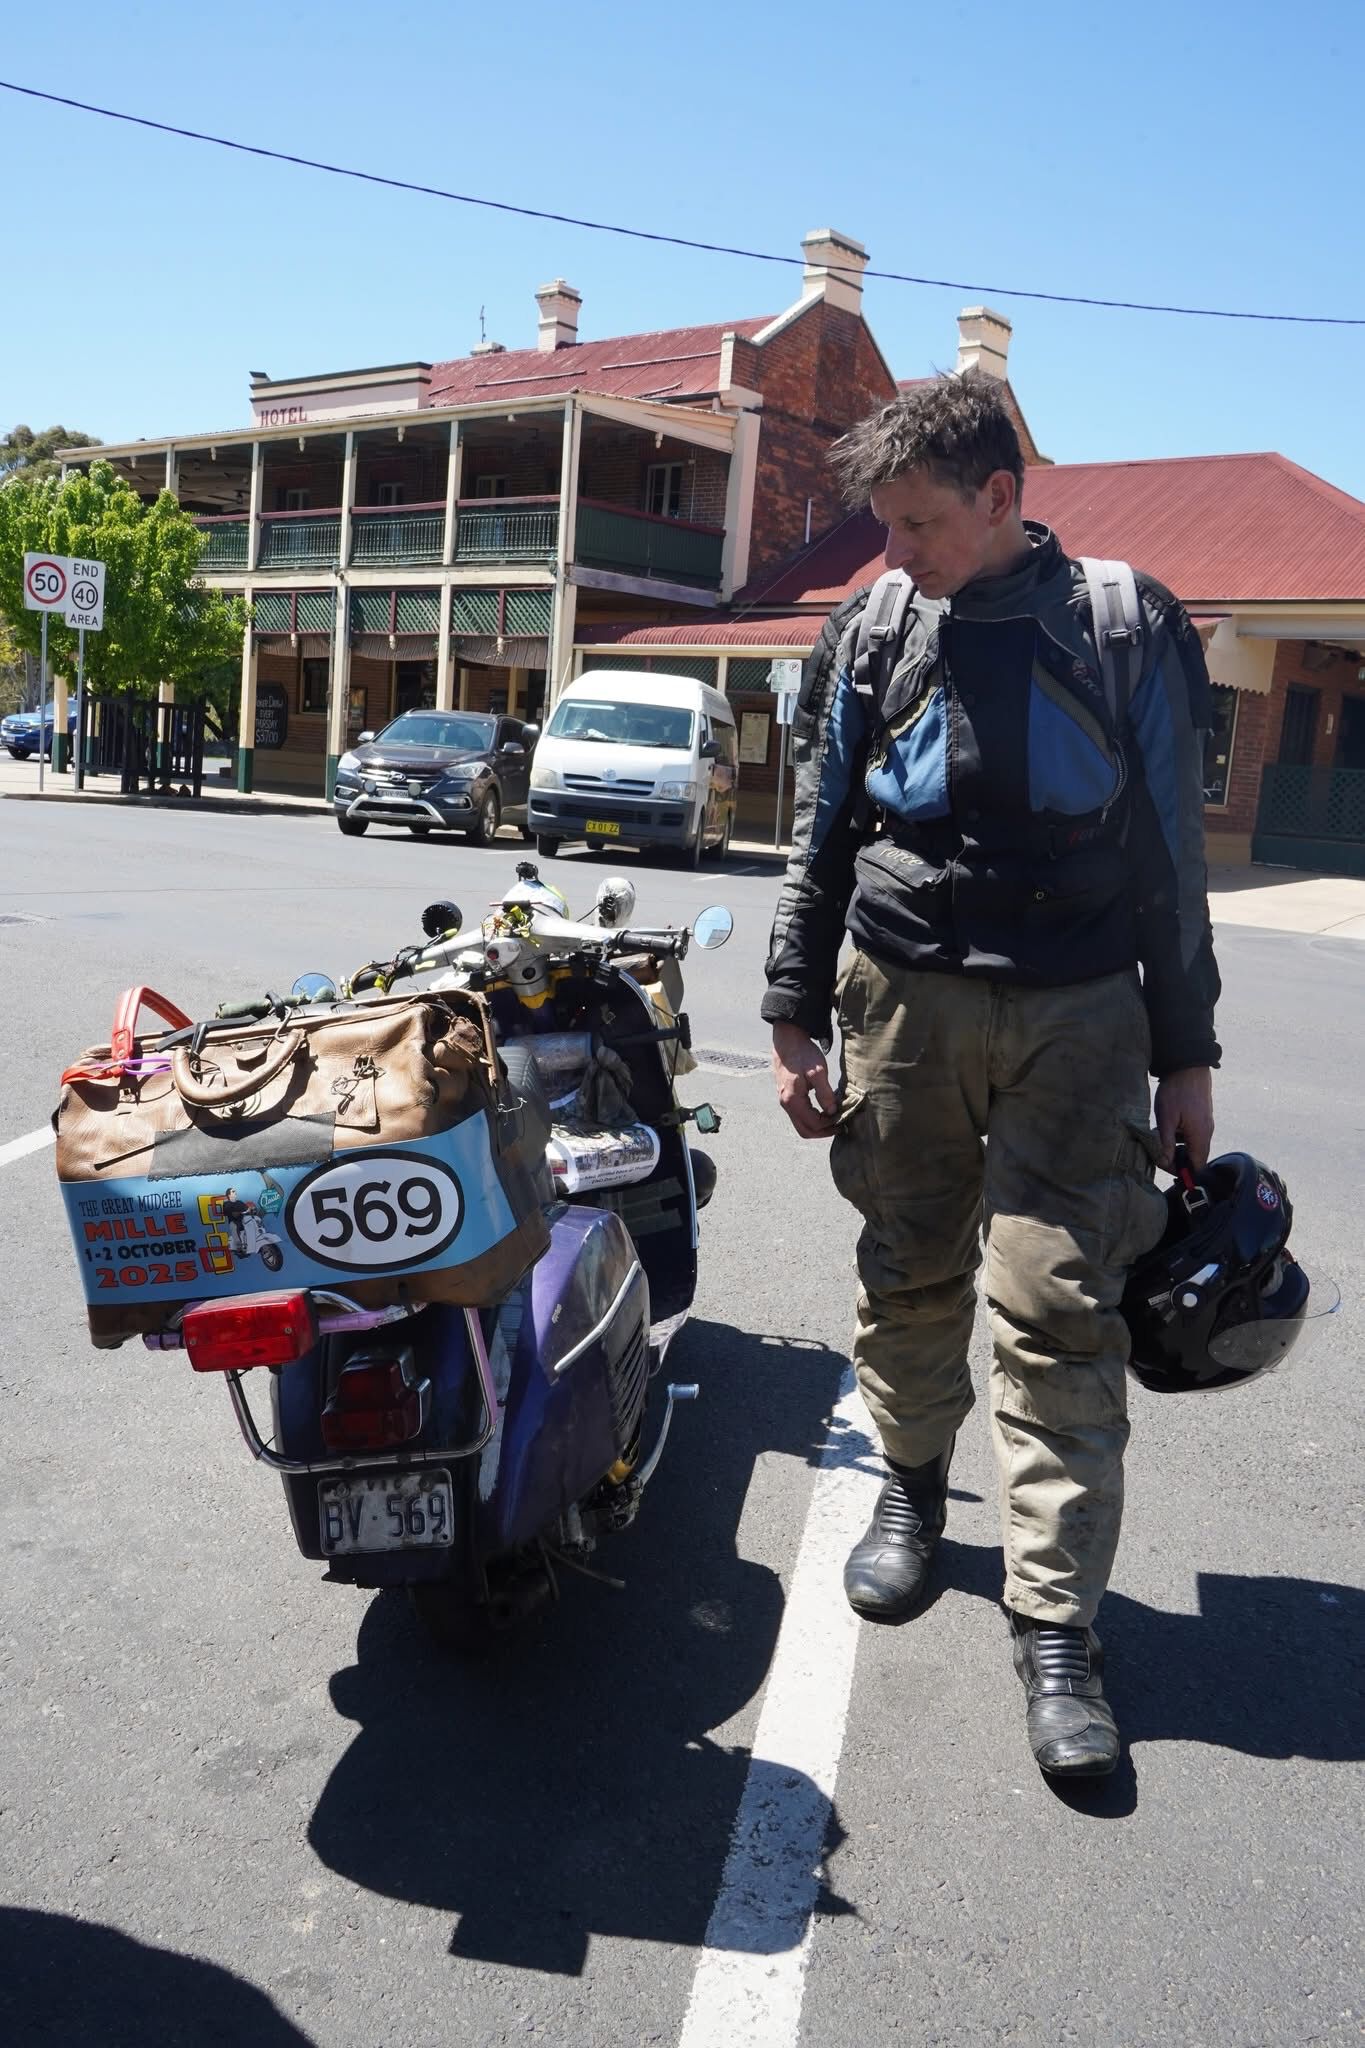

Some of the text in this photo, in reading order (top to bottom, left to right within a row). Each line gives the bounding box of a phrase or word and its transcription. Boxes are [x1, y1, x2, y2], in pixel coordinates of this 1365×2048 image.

[261, 406, 306, 426] HOTEL
[73, 563, 99, 578] END
[35, 572, 59, 593] 50
[74, 588, 96, 604] 40
[70, 613, 99, 626] AREA
[78, 1190, 183, 1217] THE GREAT MUDGEE
[310, 1176, 443, 1248] 569
[84, 1213, 188, 1242] MILLE
[117, 1239, 197, 1260] OCTOBER
[95, 1260, 199, 1289] 2025
